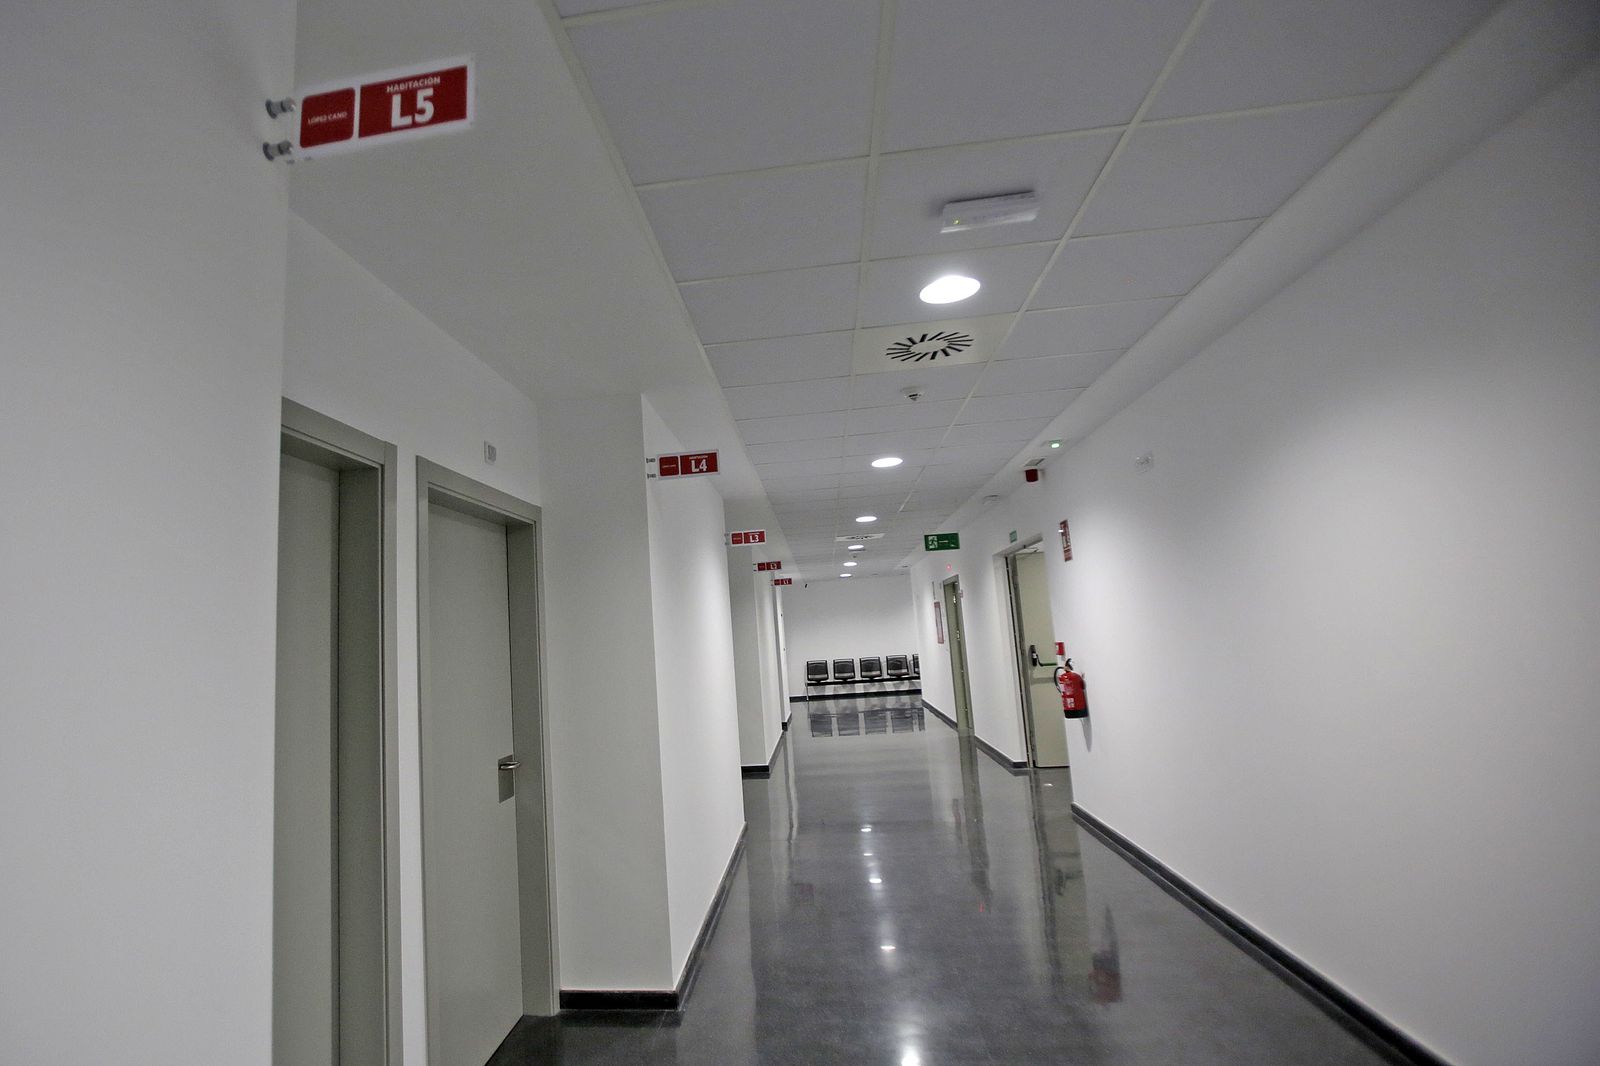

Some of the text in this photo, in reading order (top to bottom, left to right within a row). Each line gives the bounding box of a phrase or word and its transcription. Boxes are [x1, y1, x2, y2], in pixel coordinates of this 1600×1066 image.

[391, 87, 435, 128] L5
[691, 459, 708, 473] L4
[749, 534, 760, 543] L3
